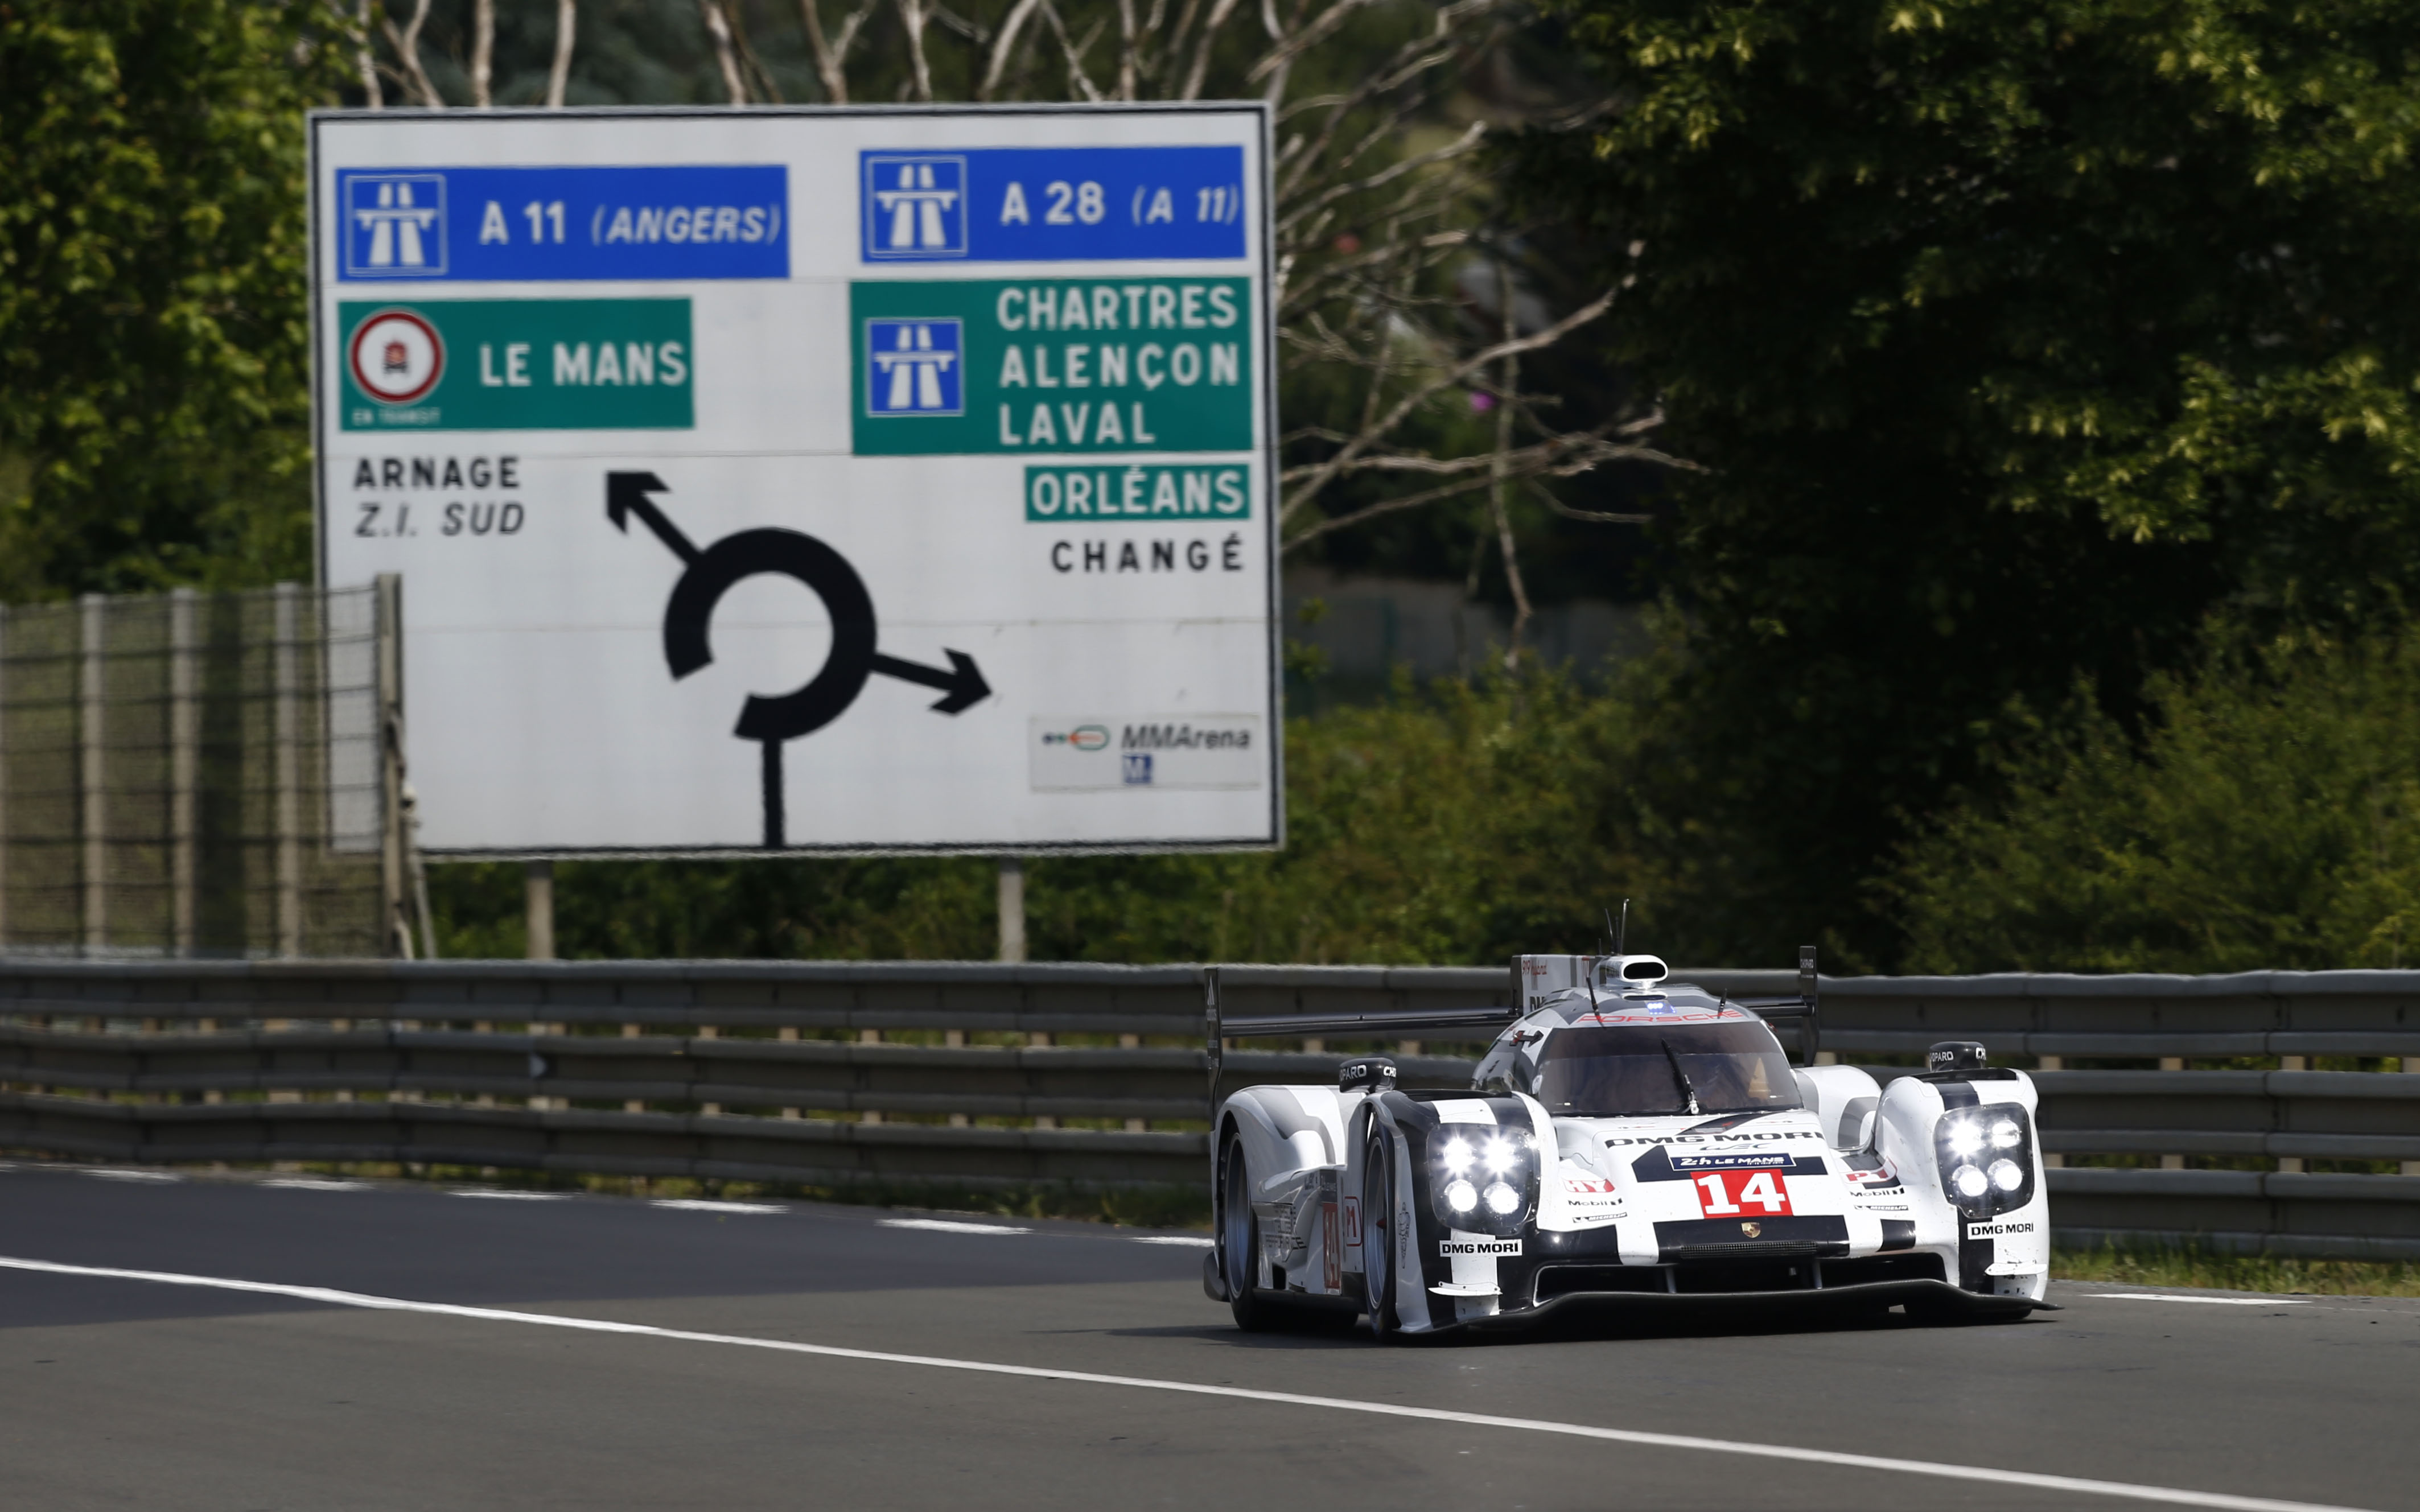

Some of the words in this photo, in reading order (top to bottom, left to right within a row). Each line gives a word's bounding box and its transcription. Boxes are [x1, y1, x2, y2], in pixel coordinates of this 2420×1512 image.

[1000, 182, 1030, 225] A
[1044, 180, 1105, 225] 28
[1131, 186, 1174, 225] (A
[1196, 185, 1238, 225] 11)
[479, 200, 508, 245] A
[524, 200, 565, 245] 11
[591, 204, 781, 245] (ANGERS)
[997, 285, 1238, 332] CHARTRES
[480, 343, 532, 387] LE
[553, 340, 688, 387] MANS
[999, 342, 1240, 390] ALENÇON
[999, 401, 1157, 446] LAVAL
[353, 456, 520, 490] ARNAGE
[1031, 467, 1245, 516] ORLÉANS
[354, 502, 418, 538] Z.I.
[441, 501, 525, 537] SUD
[1051, 532, 1243, 573] CHANGÉ
[1121, 724, 1252, 750] MMArena
[1577, 1010, 1744, 1023] PORSCHE
[1605, 1135, 1705, 1149] DMG
[1714, 1131, 1826, 1143] MORI
[1699, 1142, 1771, 1151] WEC
[1680, 1156, 1711, 1166] 24h
[1846, 1168, 1889, 1182] P1
[1697, 1172, 1786, 1214] 14
[1346, 1205, 1357, 1238] P1
[1971, 1225, 2003, 1236] DMG
[2006, 1222, 2034, 1234] MORI
[1442, 1243, 1475, 1254] DMG
[1477, 1242, 1519, 1254] MORI
